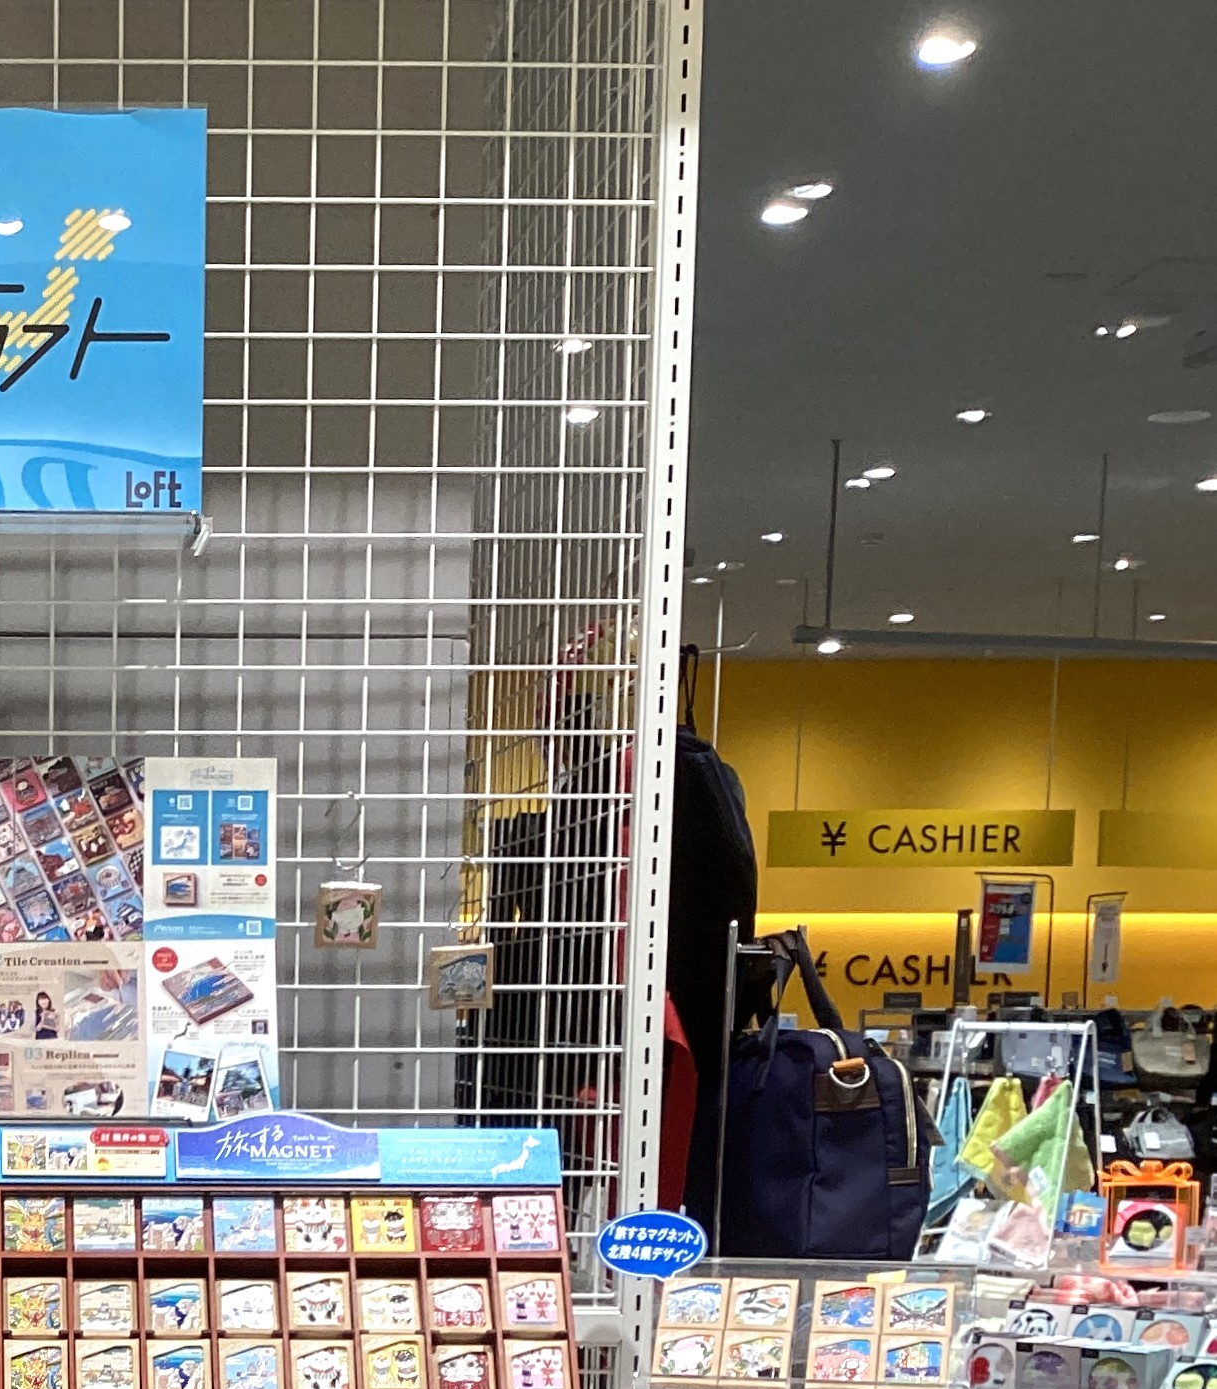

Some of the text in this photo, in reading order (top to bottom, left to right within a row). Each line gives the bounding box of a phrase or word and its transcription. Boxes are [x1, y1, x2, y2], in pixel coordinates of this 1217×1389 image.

[868, 824, 1021, 854] CASHIER
[4, 957, 28, 967] Tile
[30, 957, 81, 967] Creation
[45, 1050, 91, 1061] Replica
[249, 1144, 335, 1158] MAGNET
[607, 1243, 695, 1263] 北陸4県デザイン
